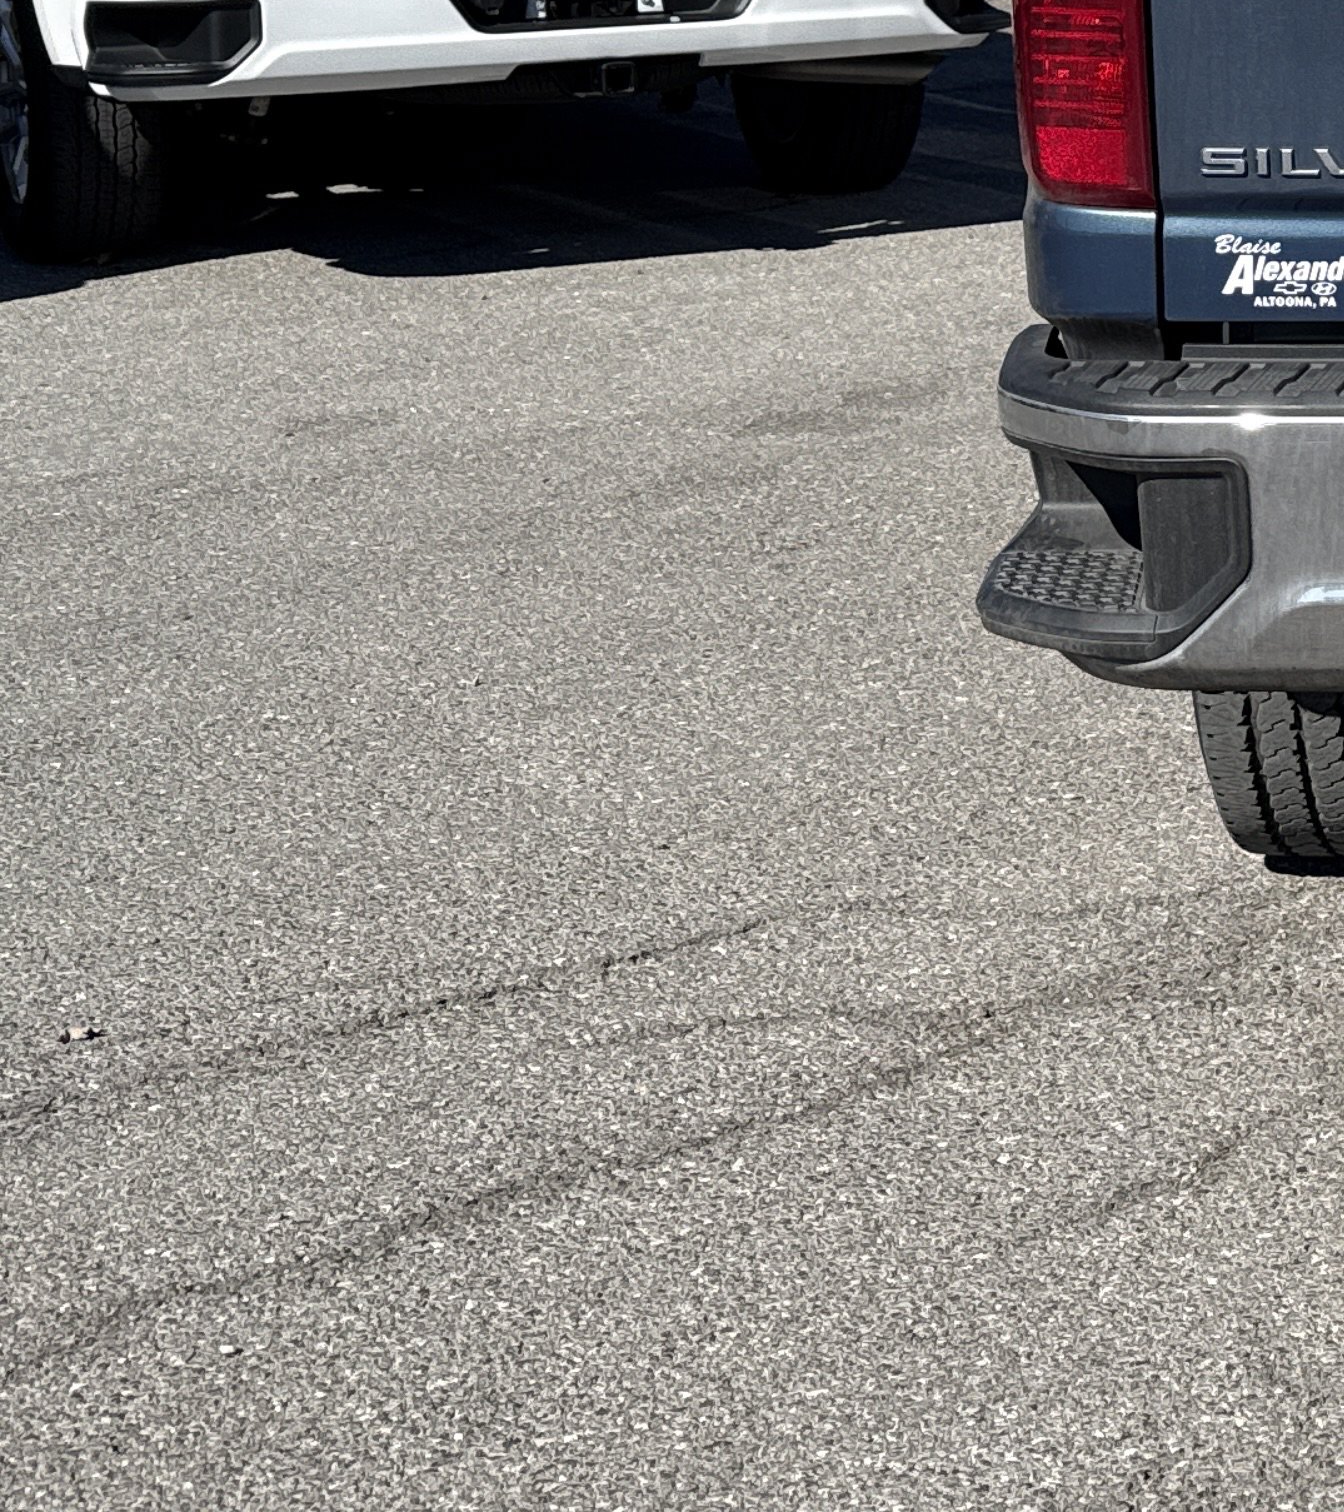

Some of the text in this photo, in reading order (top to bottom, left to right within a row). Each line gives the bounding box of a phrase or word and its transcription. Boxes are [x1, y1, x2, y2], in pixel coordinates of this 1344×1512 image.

[1214, 234, 1281, 254] Blaise
[1253, 296, 1337, 309] ALTOONA, PA
